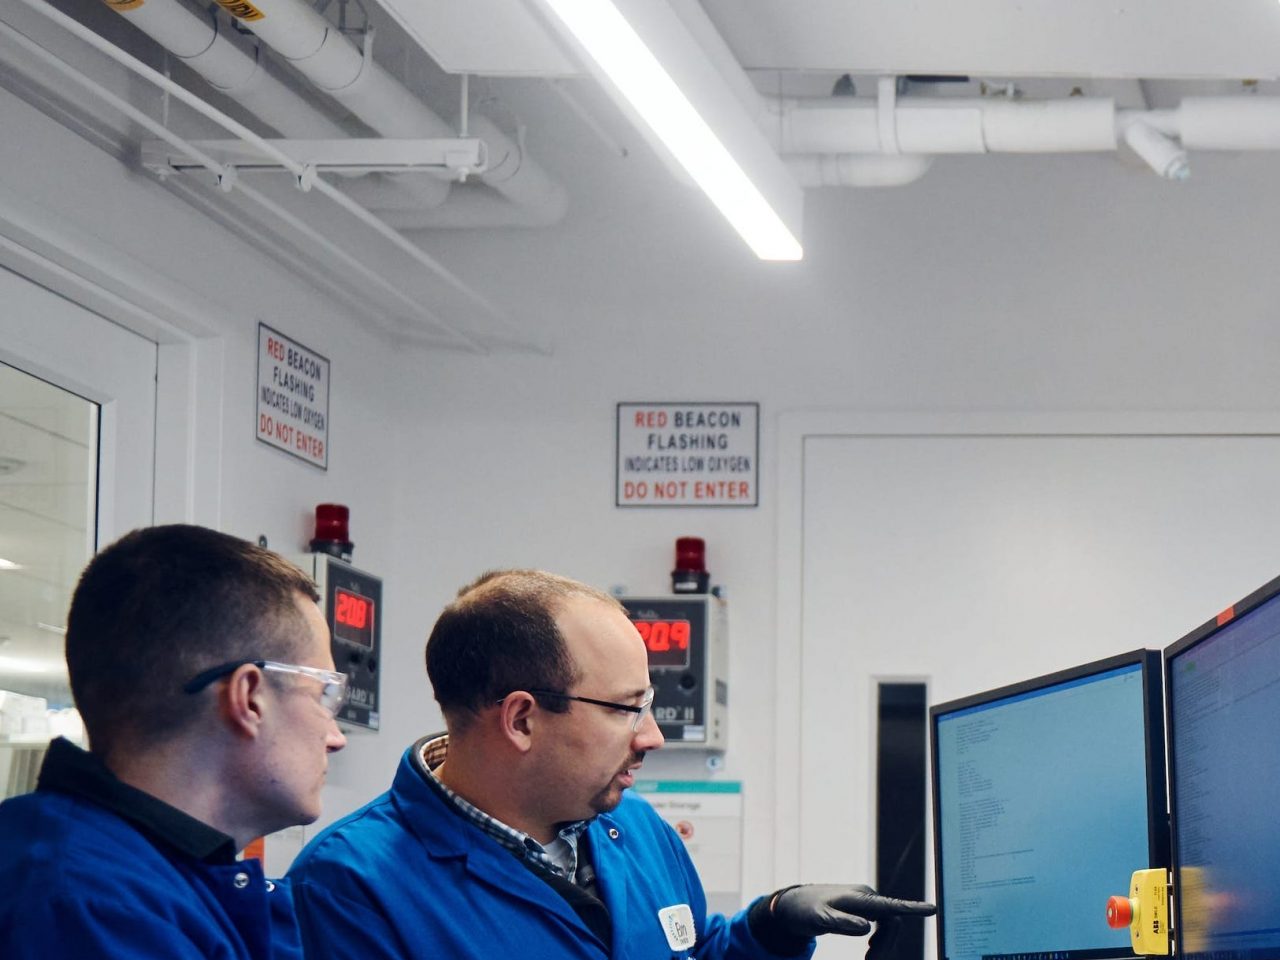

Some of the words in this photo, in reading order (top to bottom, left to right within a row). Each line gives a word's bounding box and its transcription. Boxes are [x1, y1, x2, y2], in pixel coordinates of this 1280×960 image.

[267, 337, 284, 361] RED
[288, 348, 321, 380] BEACON
[274, 366, 314, 401] FLASHING
[261, 387, 289, 414] INDICATES
[290, 401, 303, 421] LOW
[304, 406, 325, 430] OXYGEN
[635, 410, 668, 428] RED
[674, 411, 741, 427] BEACON
[261, 414, 273, 435] DO
[275, 420, 294, 445] NOT
[296, 431, 323, 458] ENTER
[648, 434, 728, 450] FLASHING
[624, 455, 679, 472] INDICATES
[681, 455, 705, 472] LOW
[708, 455, 751, 472] OXYGEN
[624, 480, 648, 499] DO
[655, 480, 688, 499] NOT
[694, 480, 750, 499] ENTER
[1152, 919, 1160, 935] ABB
